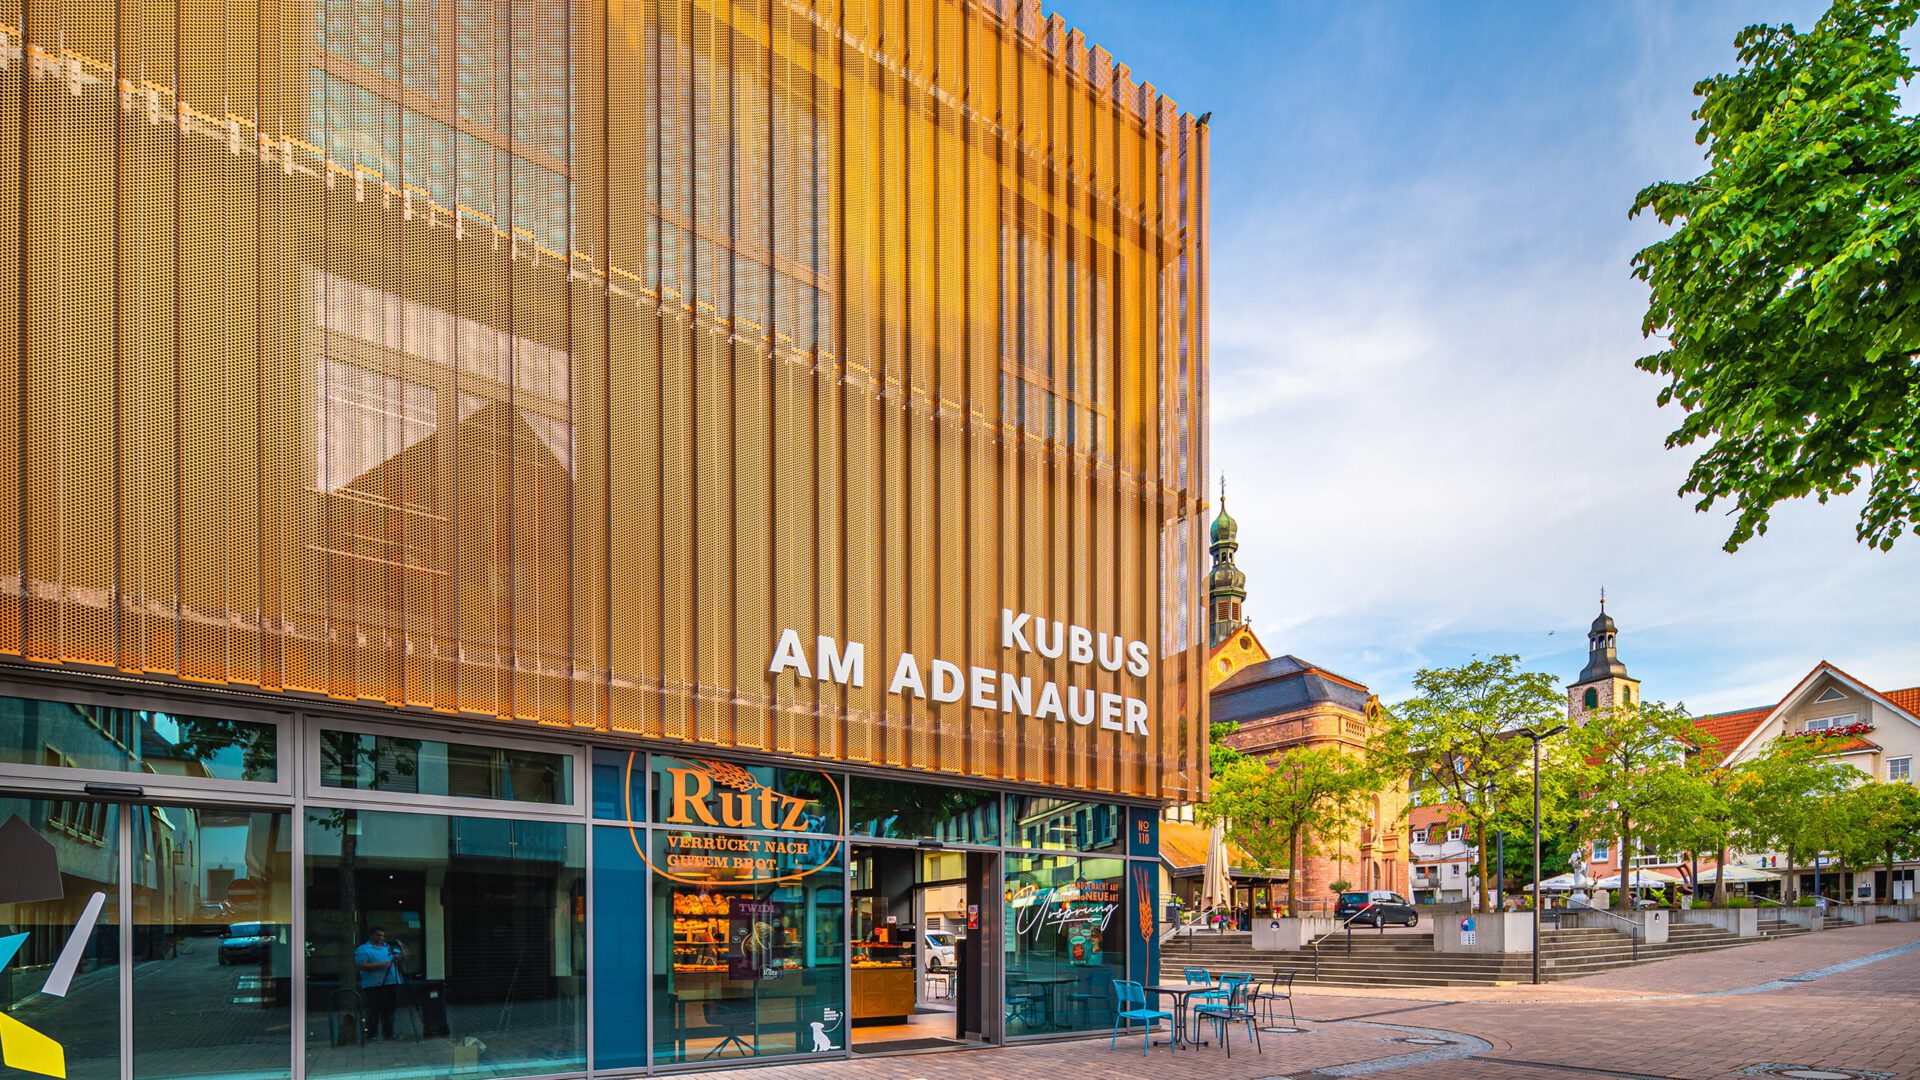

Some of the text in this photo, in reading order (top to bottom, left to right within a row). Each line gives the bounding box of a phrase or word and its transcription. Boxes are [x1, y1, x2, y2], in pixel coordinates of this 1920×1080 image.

[1002, 608, 1149, 678] KUBUS
[769, 628, 1149, 736] AM ADENAUER
[667, 836, 808, 854] VERRÜCKT NACH
[1138, 833, 1150, 845] 110
[667, 854, 779, 871] GUTEM BROT.
[1013, 884, 1119, 941] Ursprung
